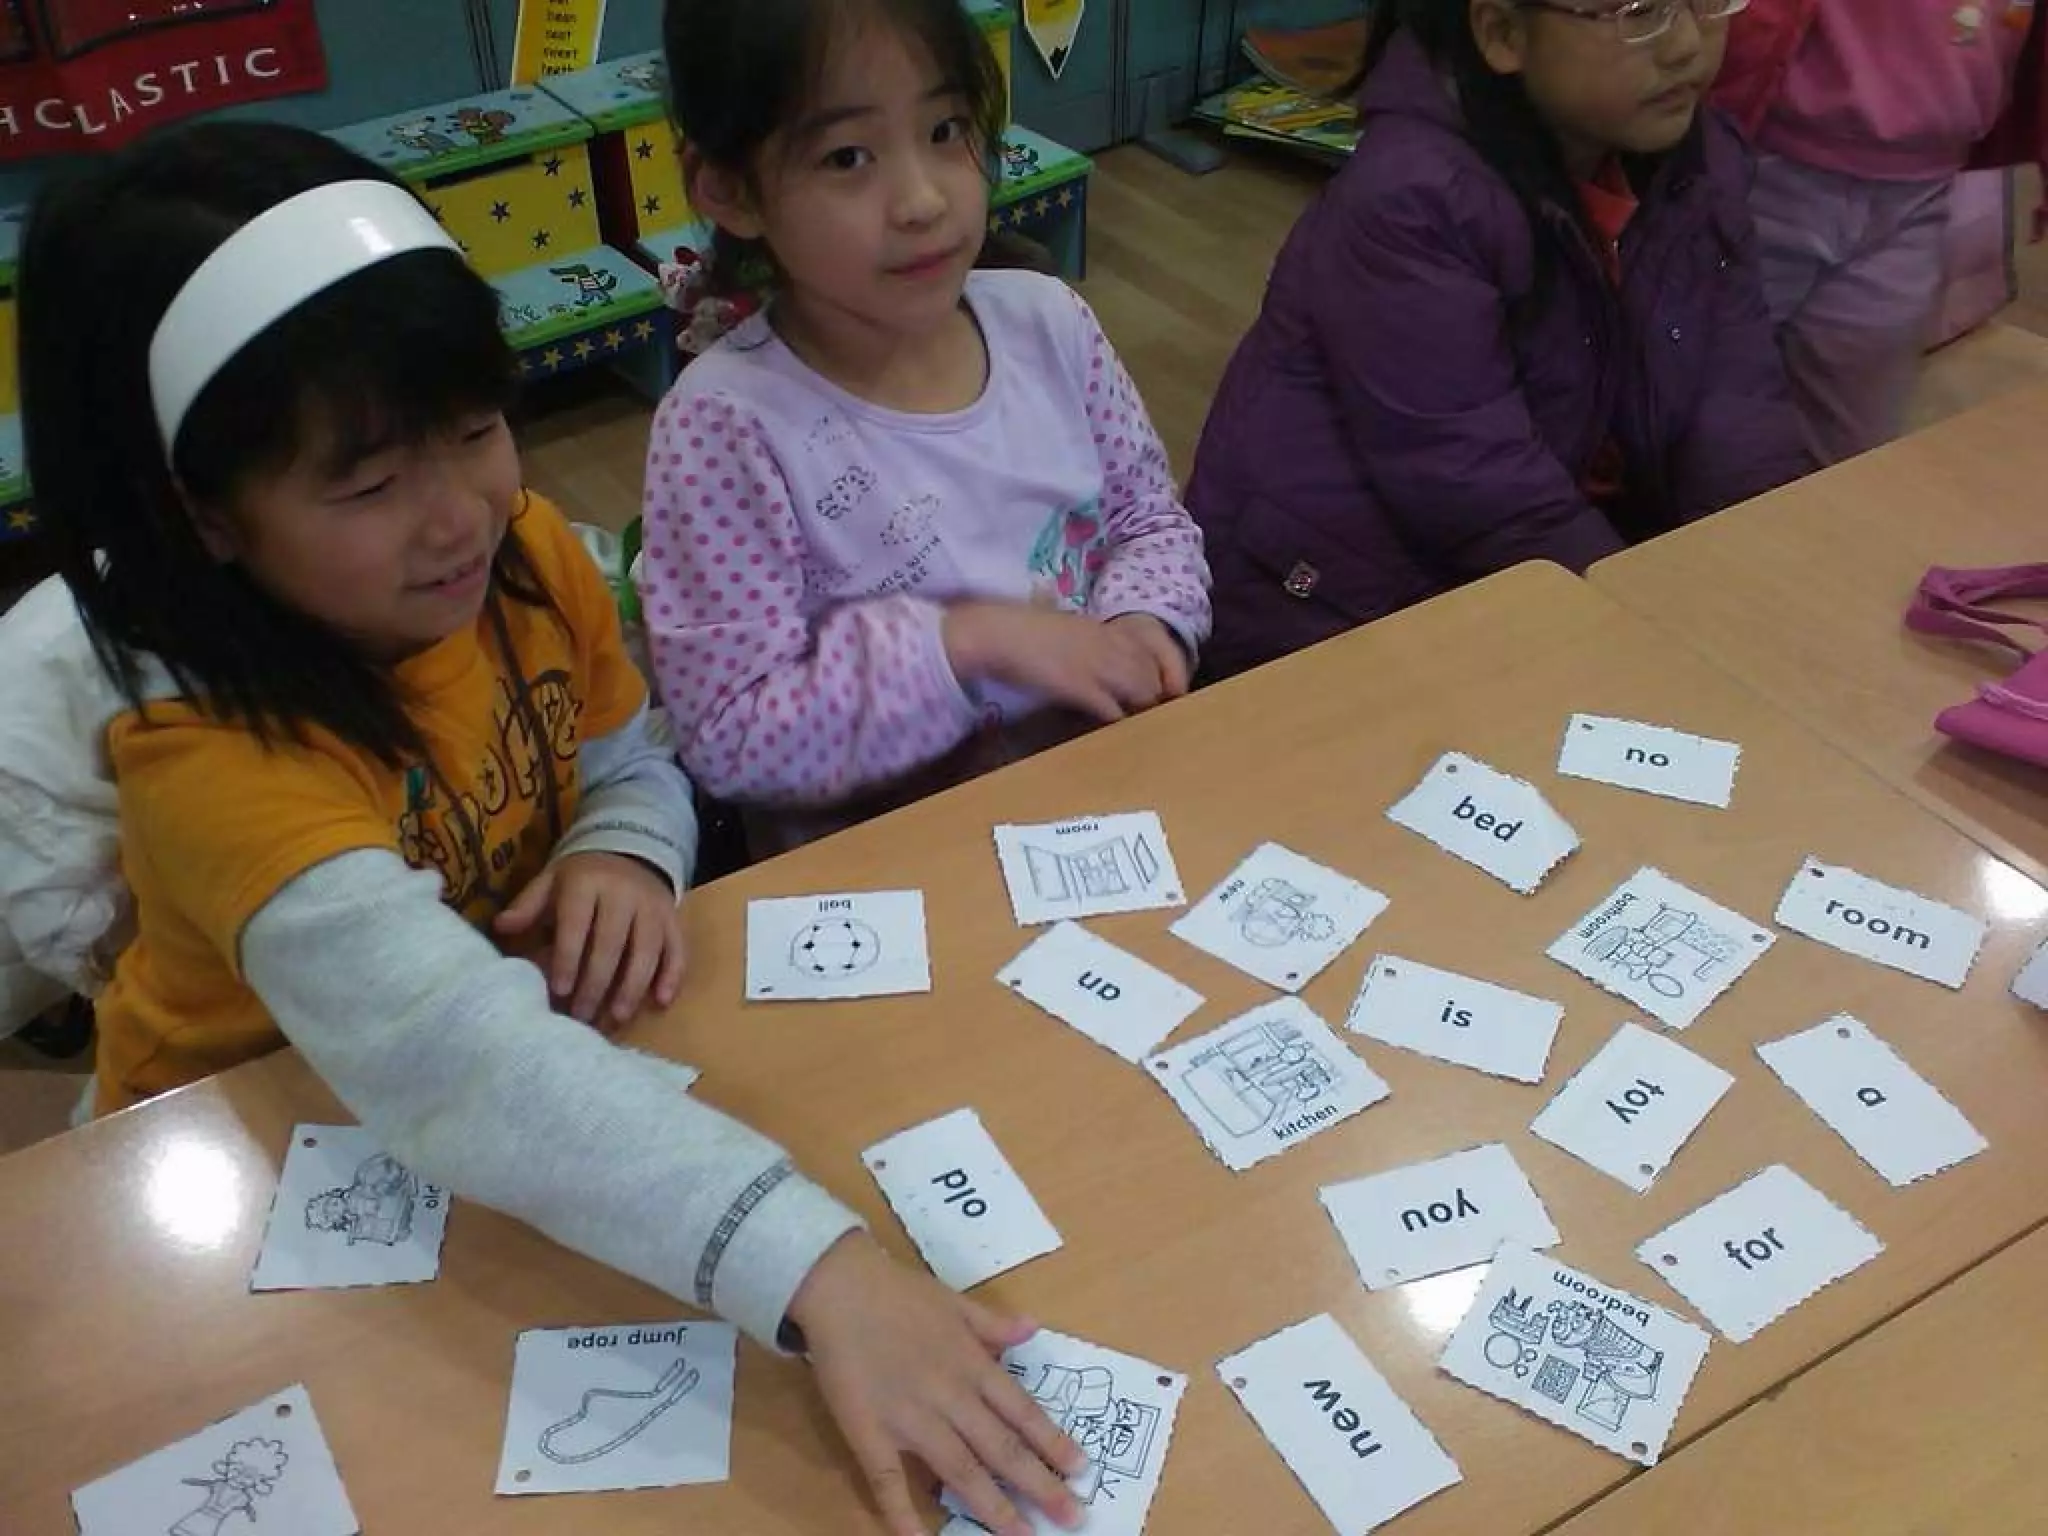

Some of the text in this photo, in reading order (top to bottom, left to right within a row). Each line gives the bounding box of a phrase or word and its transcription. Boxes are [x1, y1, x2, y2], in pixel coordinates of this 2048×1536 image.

[1625, 747, 1670, 767] no
[1055, 823, 1099, 835] room
[1452, 795, 1523, 843] bed
[819, 899, 851, 912] ball
[1824, 898, 1932, 950] room
[1077, 970, 1121, 1001] an
[1441, 1000, 1473, 1028] is
[1605, 1078, 1666, 1124] toy
[1856, 1086, 1887, 1107] a
[1272, 1103, 1338, 1141] kitchen
[931, 1168, 988, 1218] old
[1401, 1188, 1480, 1232] you
[1724, 1227, 1785, 1271] for
[1552, 1269, 1651, 1327] bedroom
[567, 1331, 618, 1350] rope
[1303, 1379, 1382, 1459] new
